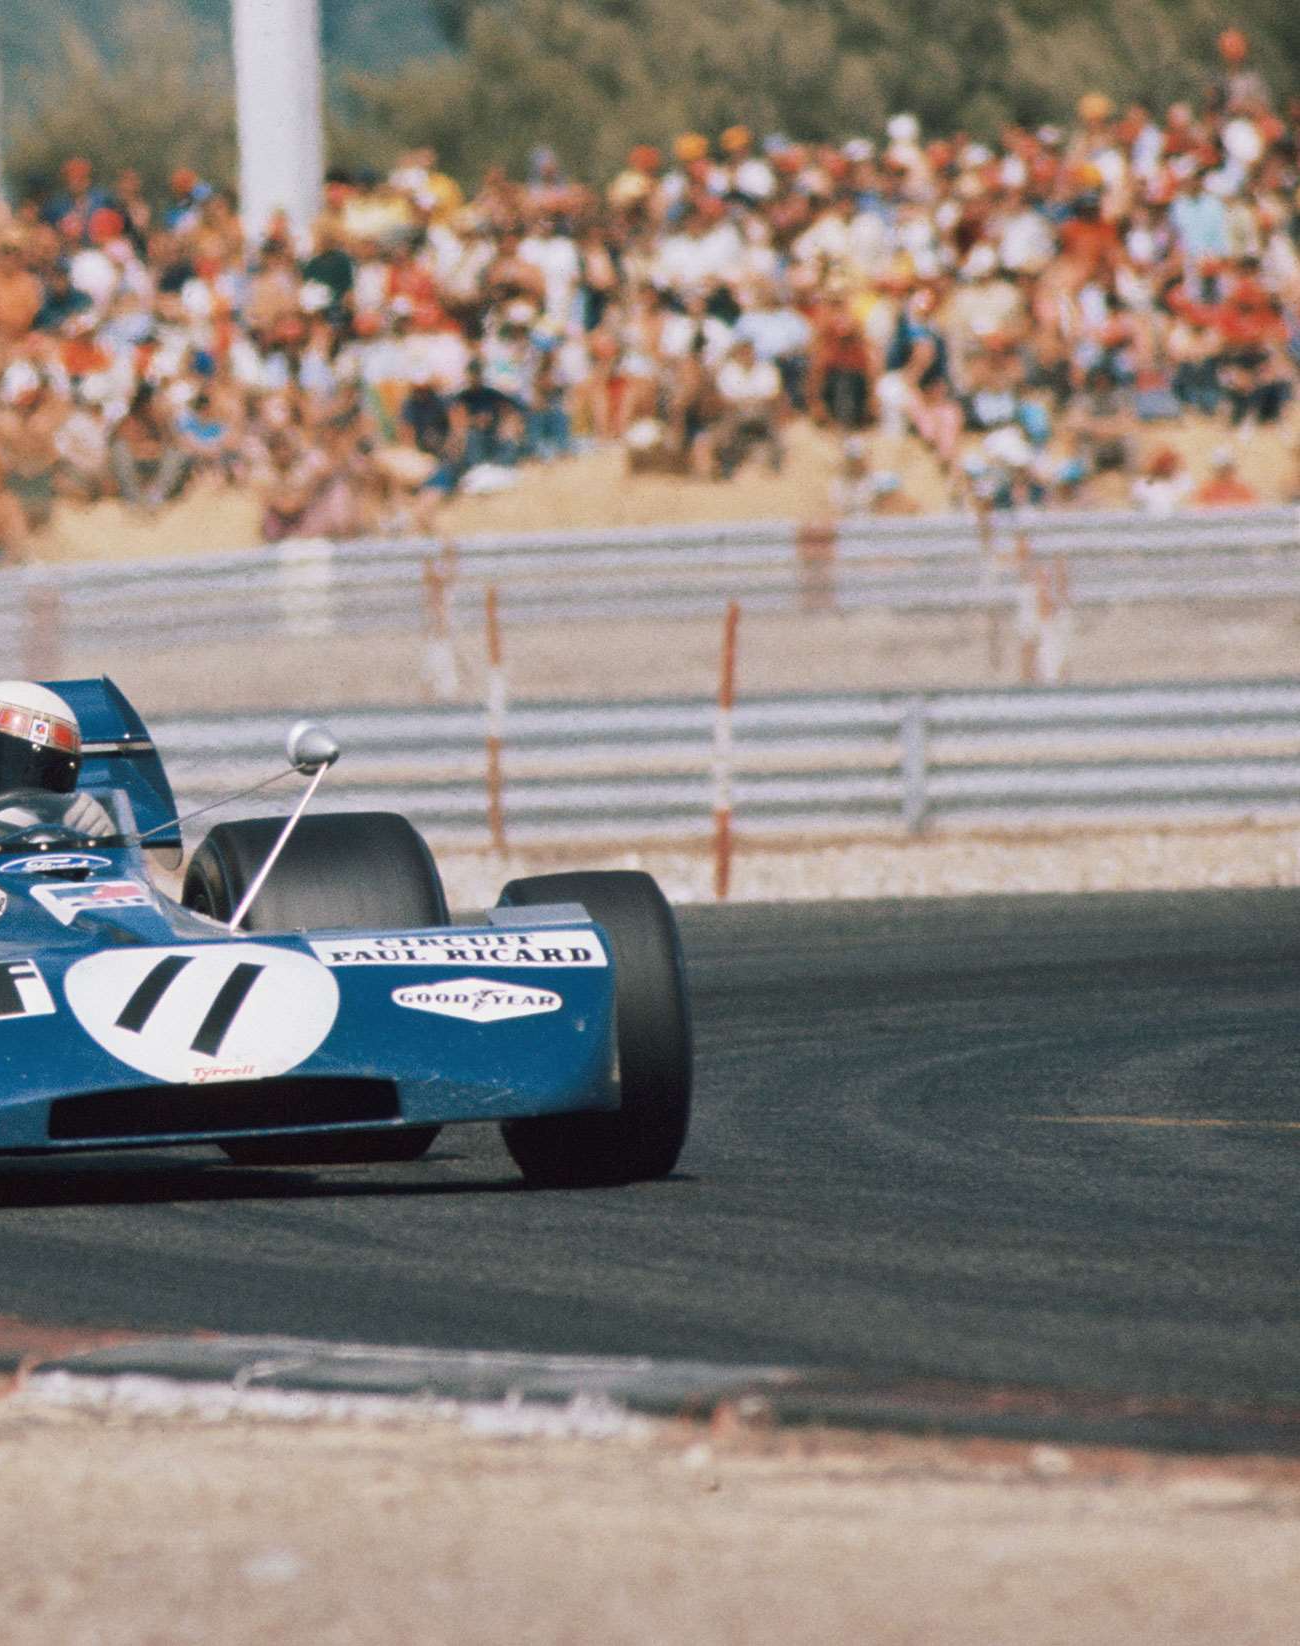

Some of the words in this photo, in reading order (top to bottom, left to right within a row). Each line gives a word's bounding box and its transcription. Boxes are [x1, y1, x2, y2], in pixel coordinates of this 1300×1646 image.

[22, 858, 89, 873] Ford
[374, 934, 536, 948] CIRCUIT
[331, 948, 427, 963] PAUL
[445, 947, 592, 963] RICARD
[114, 954, 267, 1058] 11
[193, 1065, 255, 1083] Tyrrell
